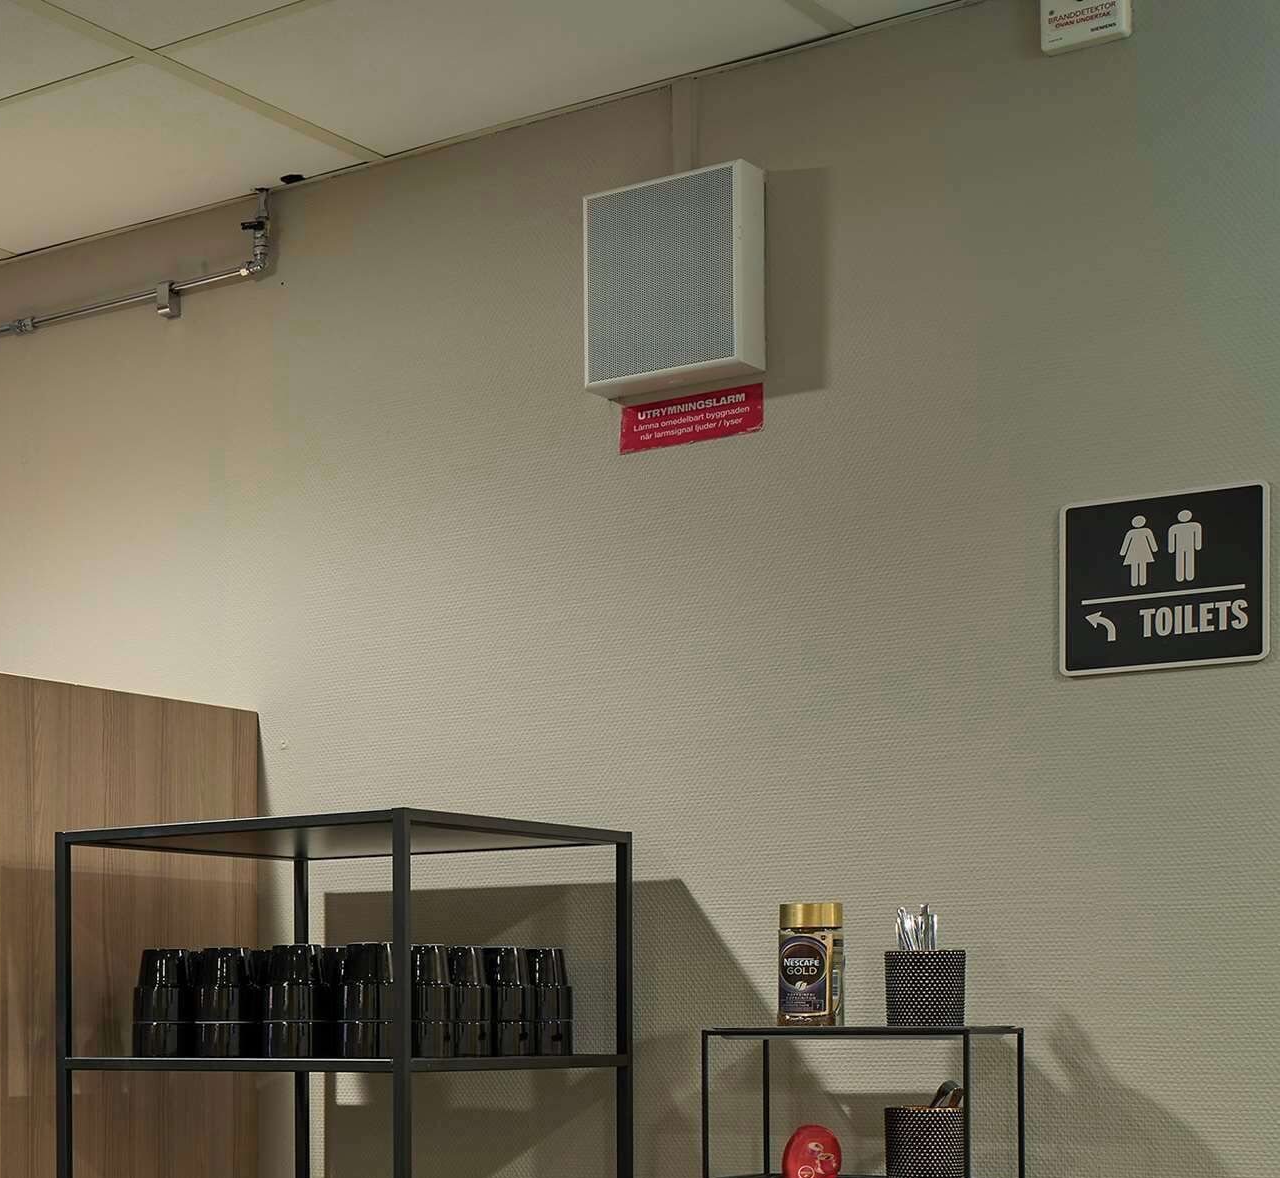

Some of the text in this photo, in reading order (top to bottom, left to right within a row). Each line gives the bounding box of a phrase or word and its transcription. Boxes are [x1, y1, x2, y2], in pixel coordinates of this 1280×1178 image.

[637, 393, 746, 420] UTRYMNINGSLARM
[660, 414, 704, 428] omedelbart
[706, 406, 750, 420] byggnaden
[654, 425, 694, 439] larmsignal
[695, 422, 716, 432] ljuder
[724, 417, 743, 428] lyser
[1139, 599, 1249, 638] TOILETS
[786, 966, 817, 975] GOLD
